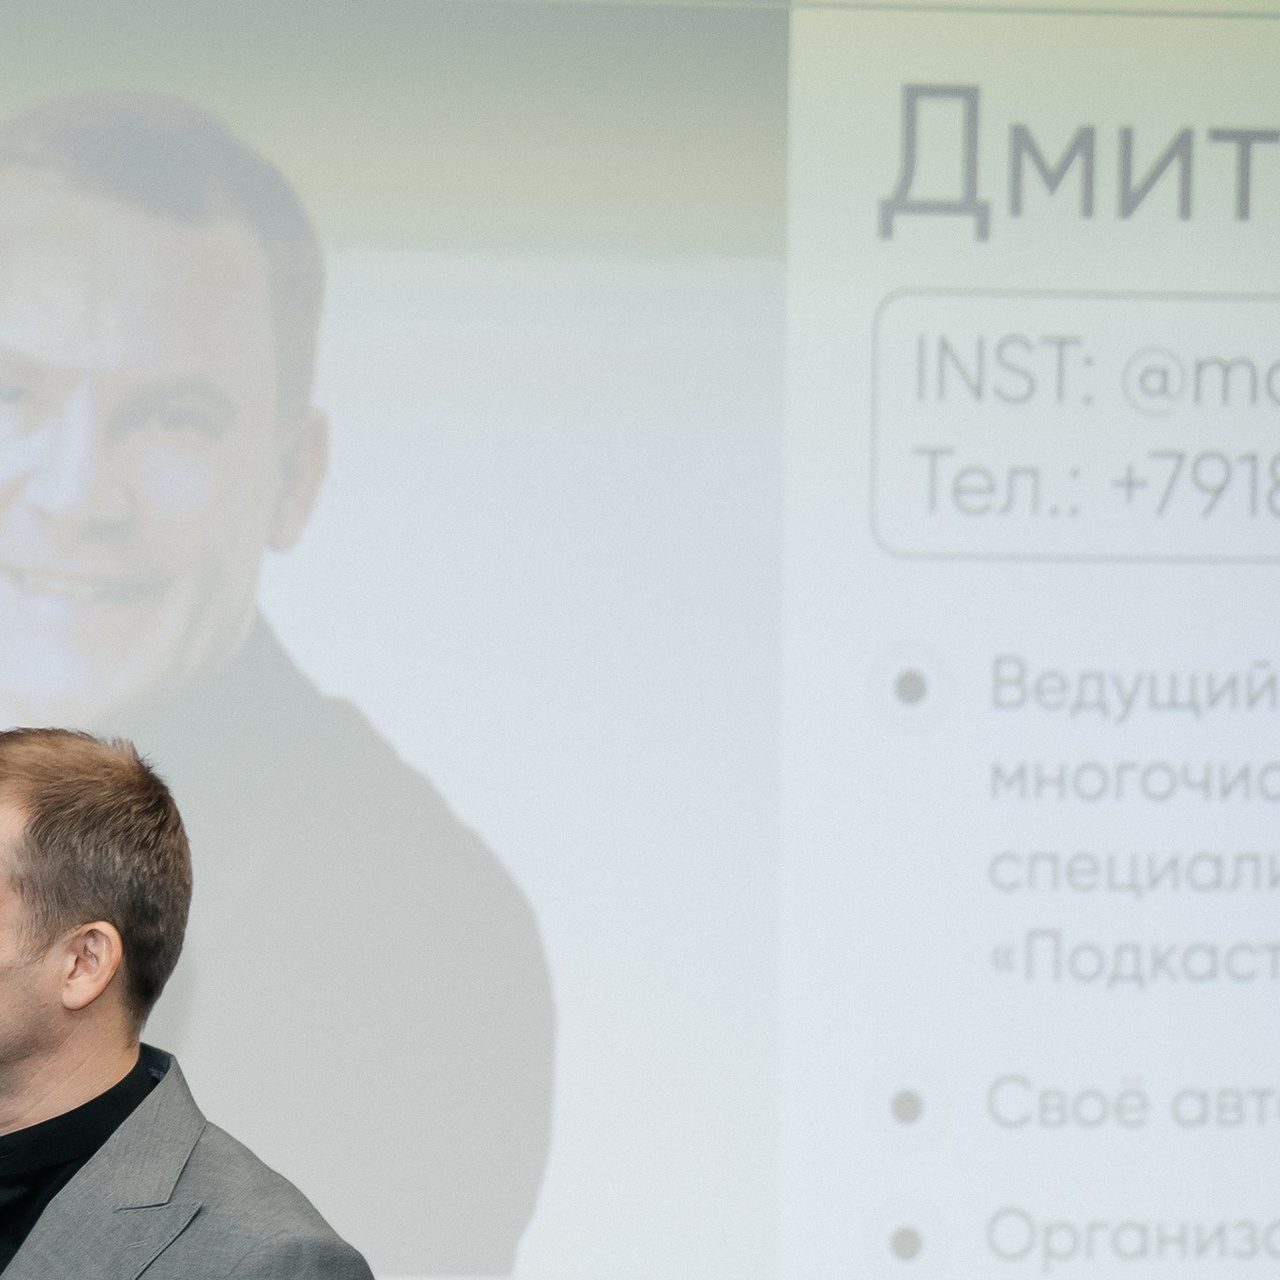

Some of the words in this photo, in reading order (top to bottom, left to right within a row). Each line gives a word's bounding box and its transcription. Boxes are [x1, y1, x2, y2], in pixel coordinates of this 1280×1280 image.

[878, 83, 1280, 242] Дмит
[916, 333, 1096, 406] INST:
[911, 446, 1081, 519] Тел.:
[993, 653, 1280, 727] Ведущий
[986, 1072, 1150, 1131] Своё
[1171, 1086, 1280, 1130] авт
